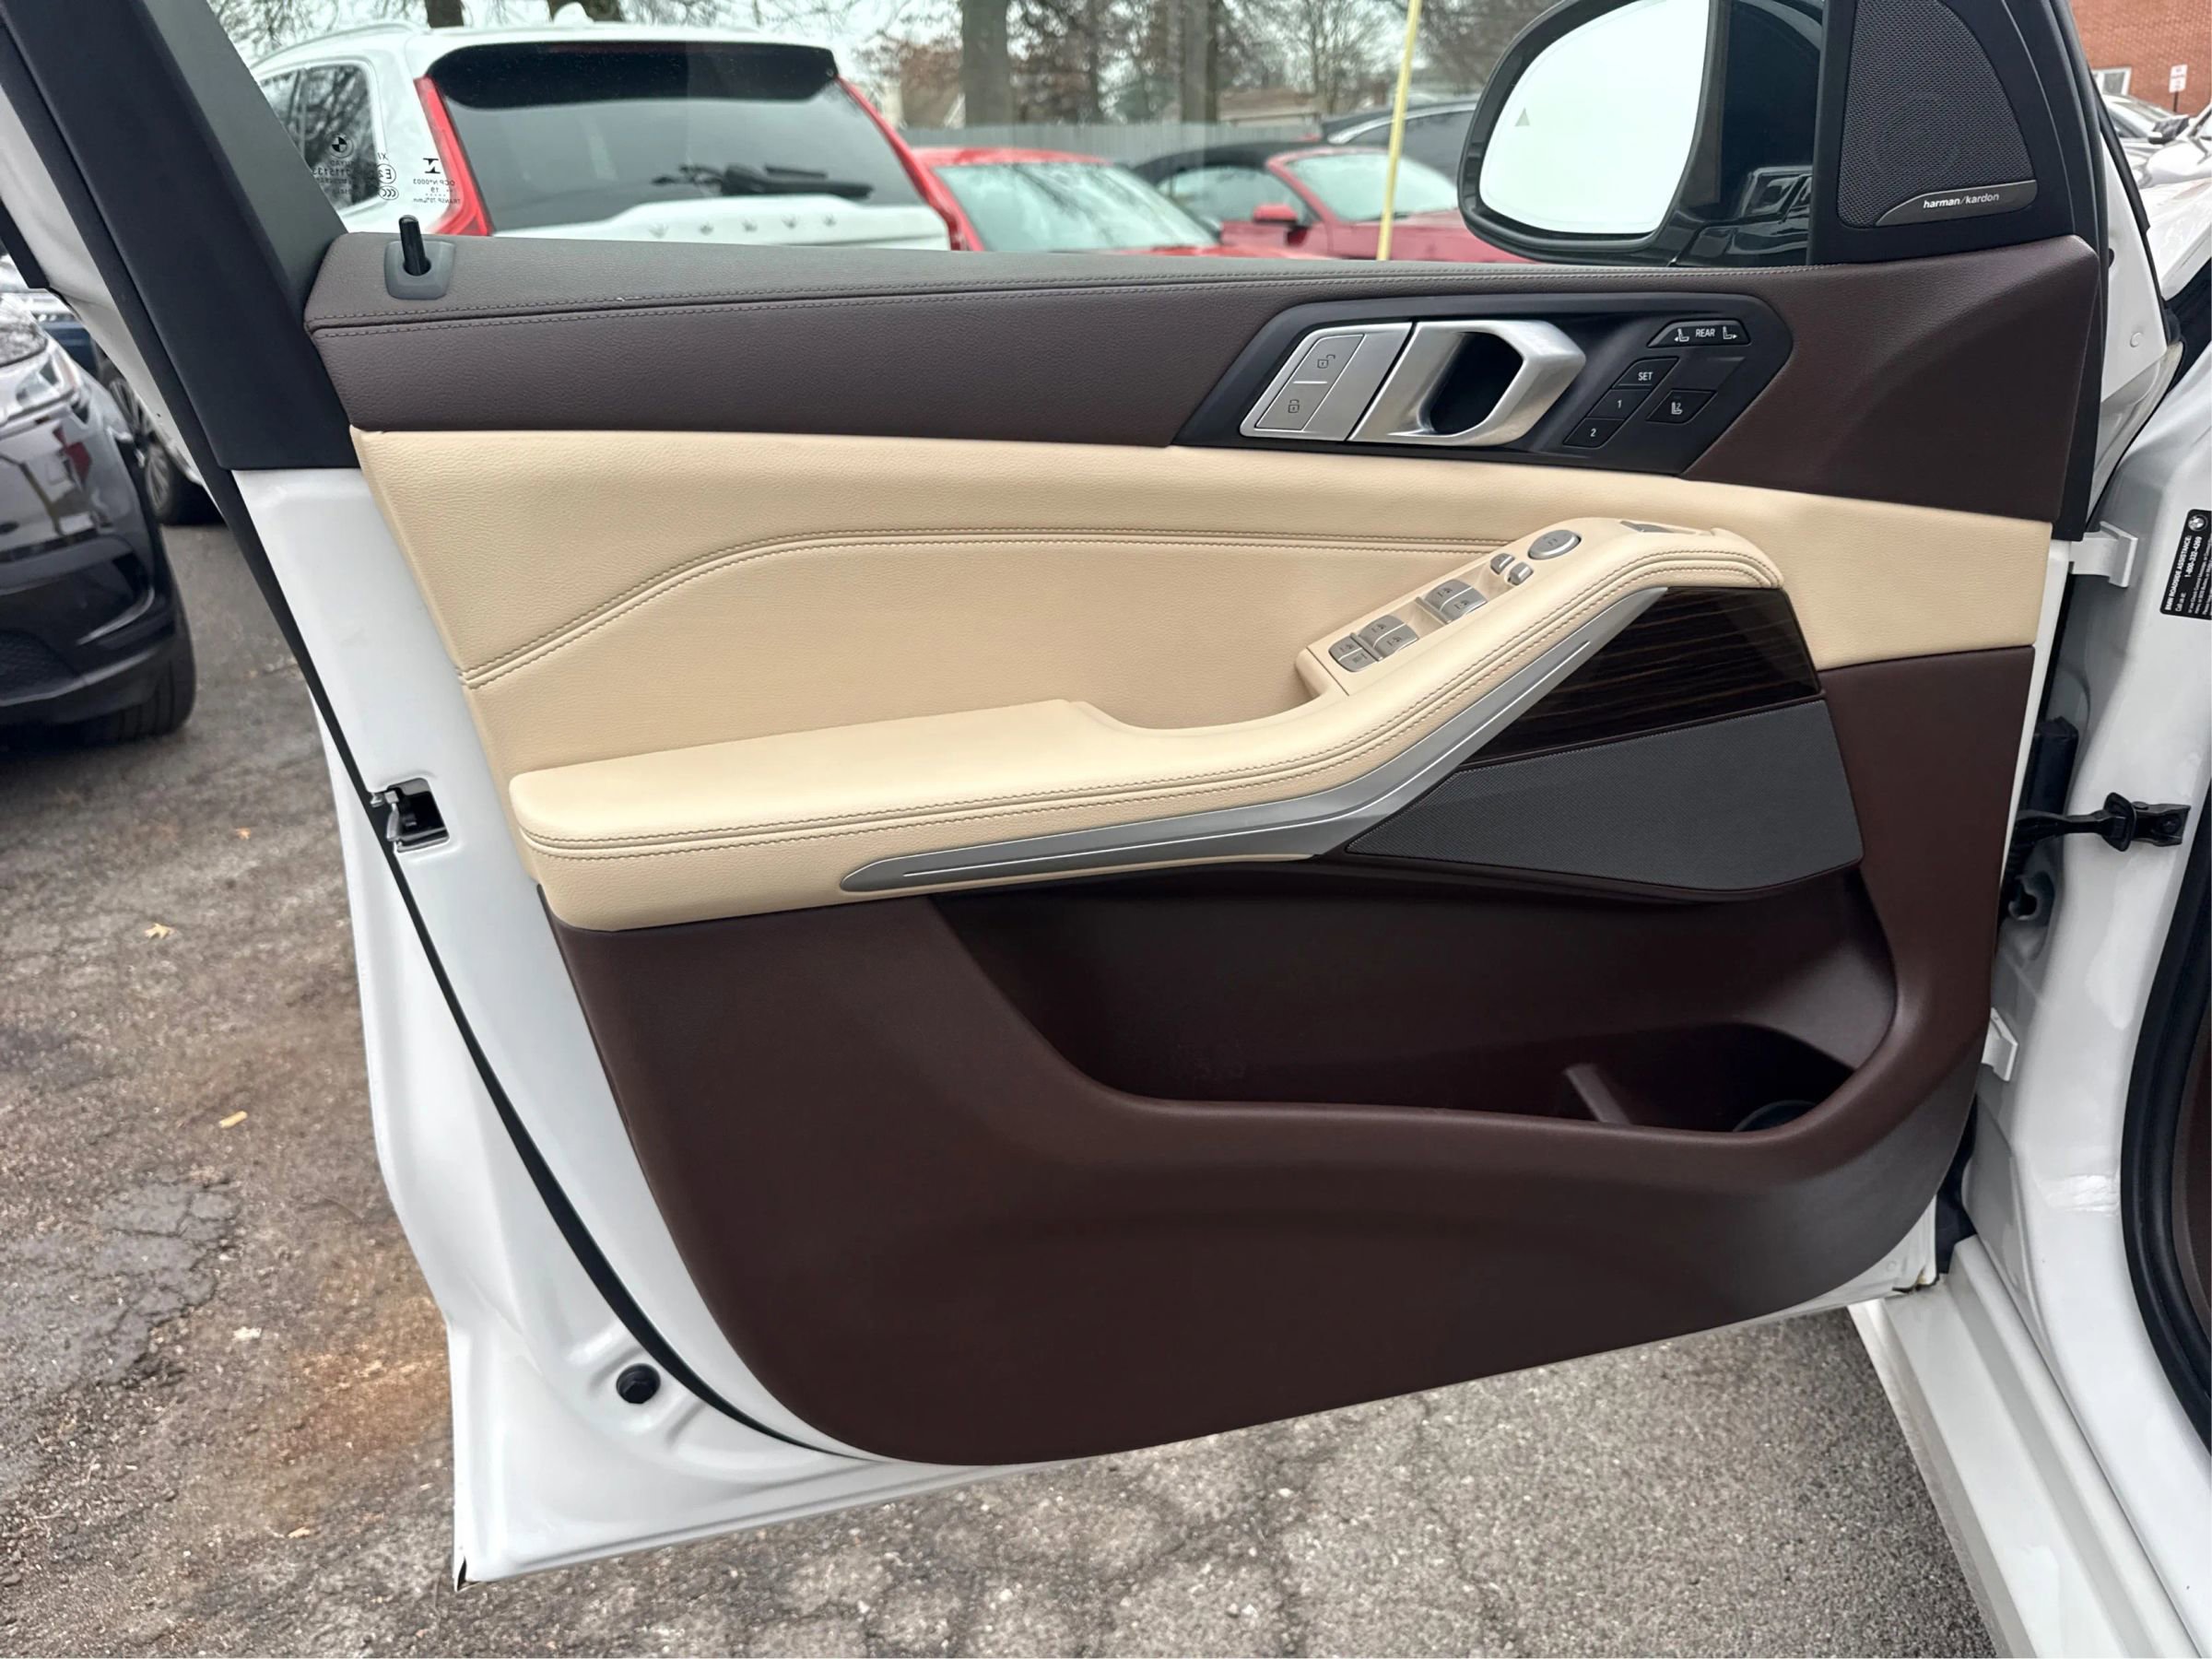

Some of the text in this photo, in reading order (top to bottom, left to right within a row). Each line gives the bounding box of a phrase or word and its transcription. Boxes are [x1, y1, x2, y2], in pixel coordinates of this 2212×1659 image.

[1923, 193, 2000, 208] harman/kardon
[1695, 328, 1716, 337] REAR
[1638, 371, 1653, 382] SET
[1617, 399, 1622, 408] 1
[1590, 428, 1596, 437] 2
[2169, 571, 2182, 597] ROADSIDE
[2165, 596, 2174, 610] BMW
